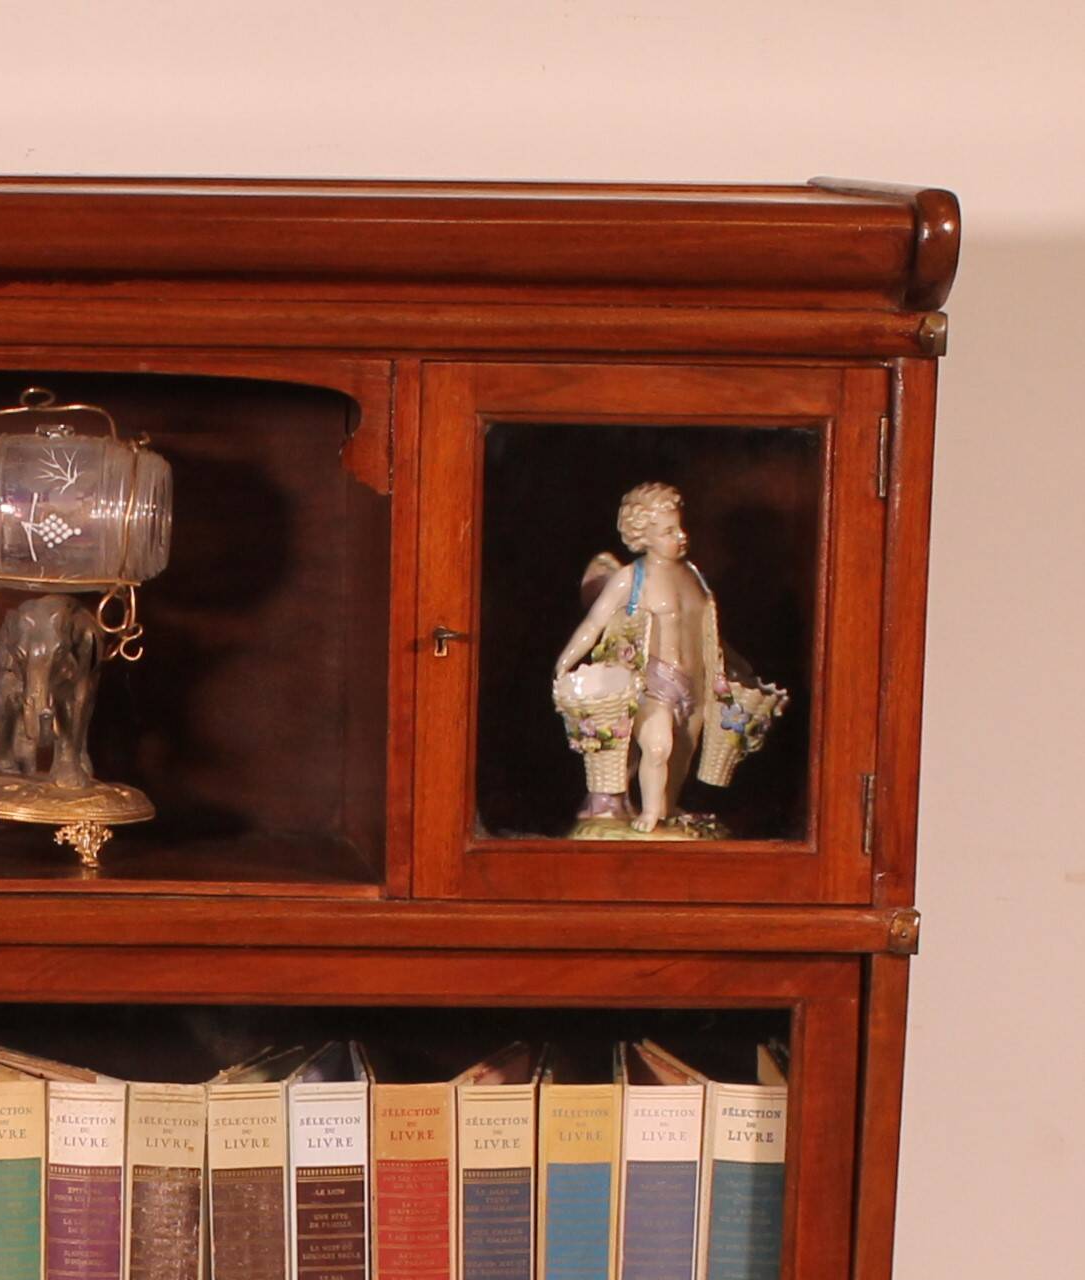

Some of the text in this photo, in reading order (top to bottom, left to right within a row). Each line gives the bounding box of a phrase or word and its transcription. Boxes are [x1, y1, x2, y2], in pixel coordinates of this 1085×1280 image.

[721, 1107, 782, 1119] SÉLECTION
[55, 1113, 116, 1126] SÉLECTION
[138, 1114, 200, 1127] SÉLECTION
[214, 1115, 277, 1127] SÉLECTION
[299, 1115, 362, 1127] SÉLECTION
[465, 1115, 529, 1127] SÉLECTION
[64, 1136, 109, 1148] LIVRE
[146, 1136, 190, 1148] LIVRE
[390, 1130, 435, 1142] LIVRE
[559, 1130, 603, 1142] LIVRE
[641, 1130, 687, 1142] LIVRE
[727, 1130, 774, 1143] LIVRE
[224, 1138, 270, 1149] LIVRE
[308, 1137, 354, 1149] LIVRE
[474, 1137, 520, 1150] LIVRE
